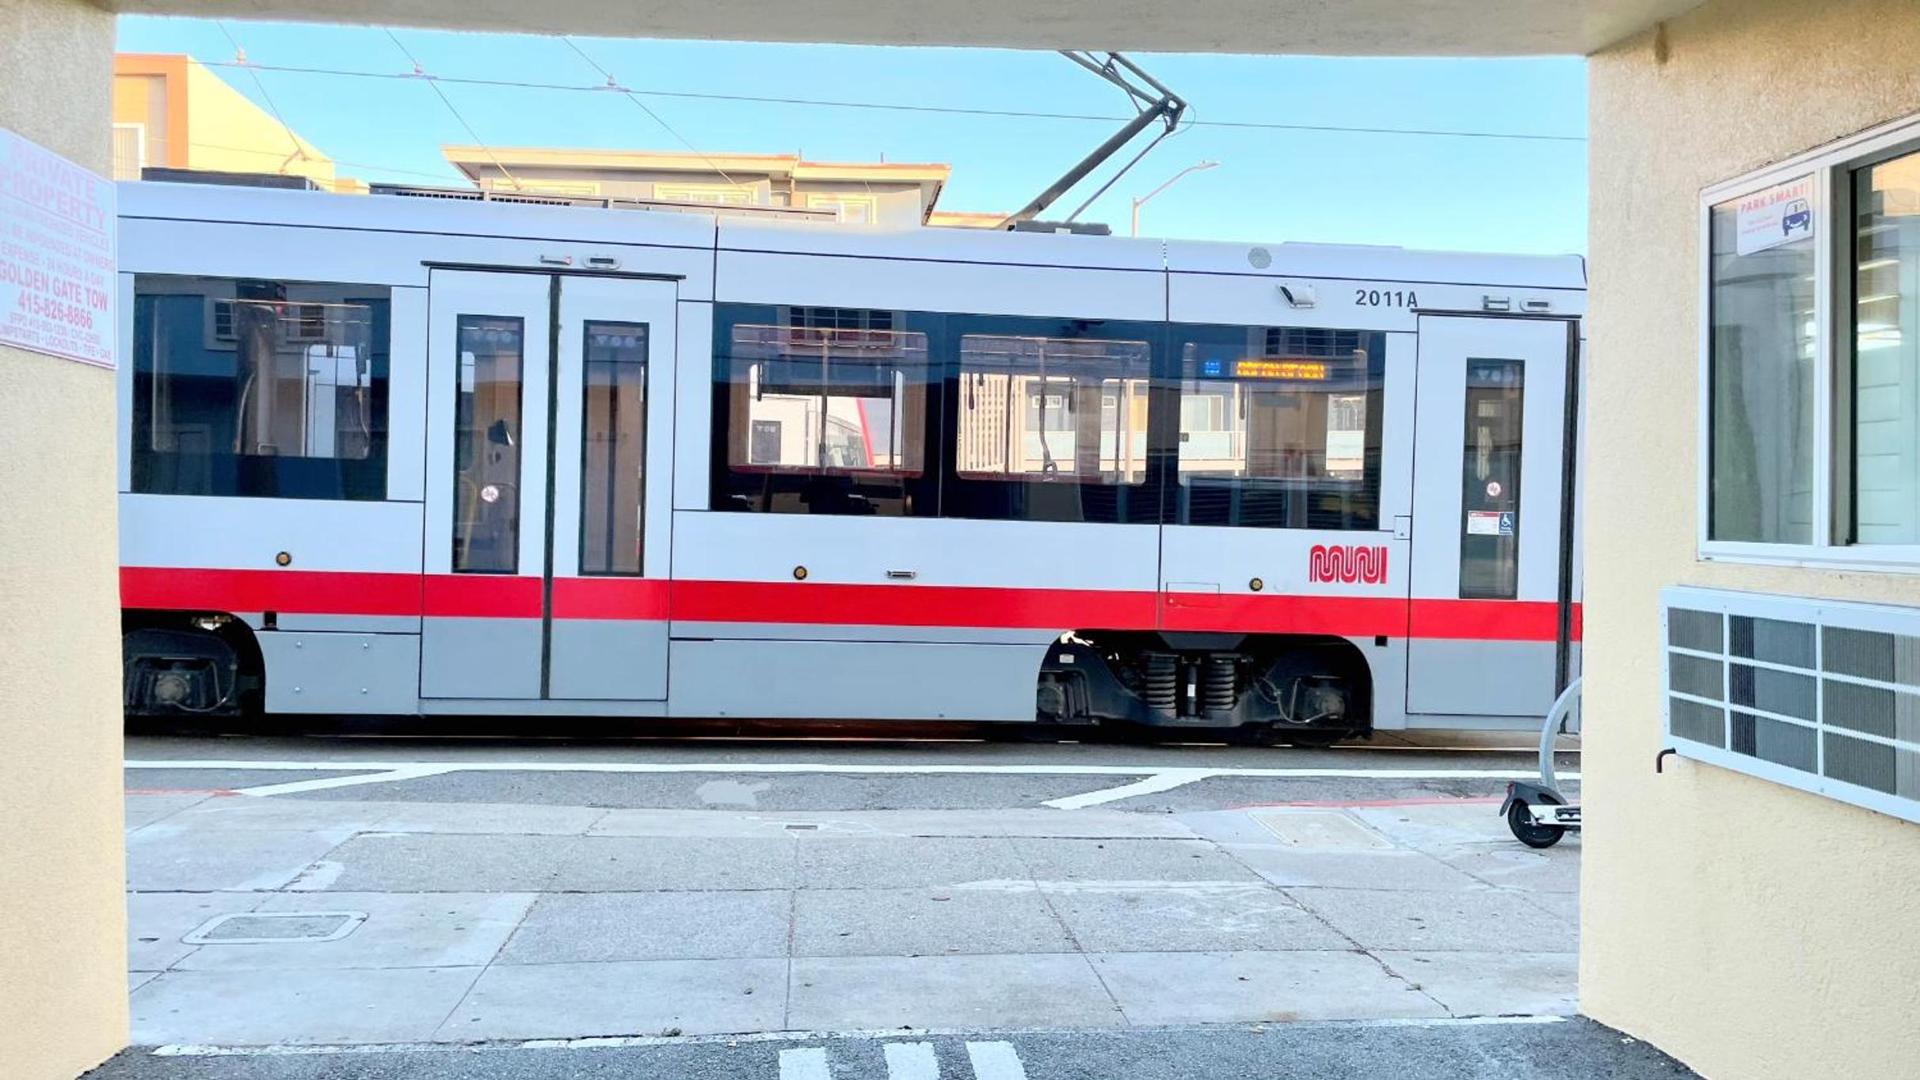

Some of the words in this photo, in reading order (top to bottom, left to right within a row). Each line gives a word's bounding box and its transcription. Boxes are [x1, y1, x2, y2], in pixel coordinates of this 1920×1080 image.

[11, 140, 95, 201] PRIVATE
[0, 163, 105, 231] PROPERTY
[1741, 197, 1766, 214] PARK
[0, 258, 48, 293] GOLDEN
[52, 275, 81, 303] GATE
[84, 285, 107, 312] TOW
[1355, 289, 1418, 308] 2011A
[1309, 544, 1387, 585] MUNI
